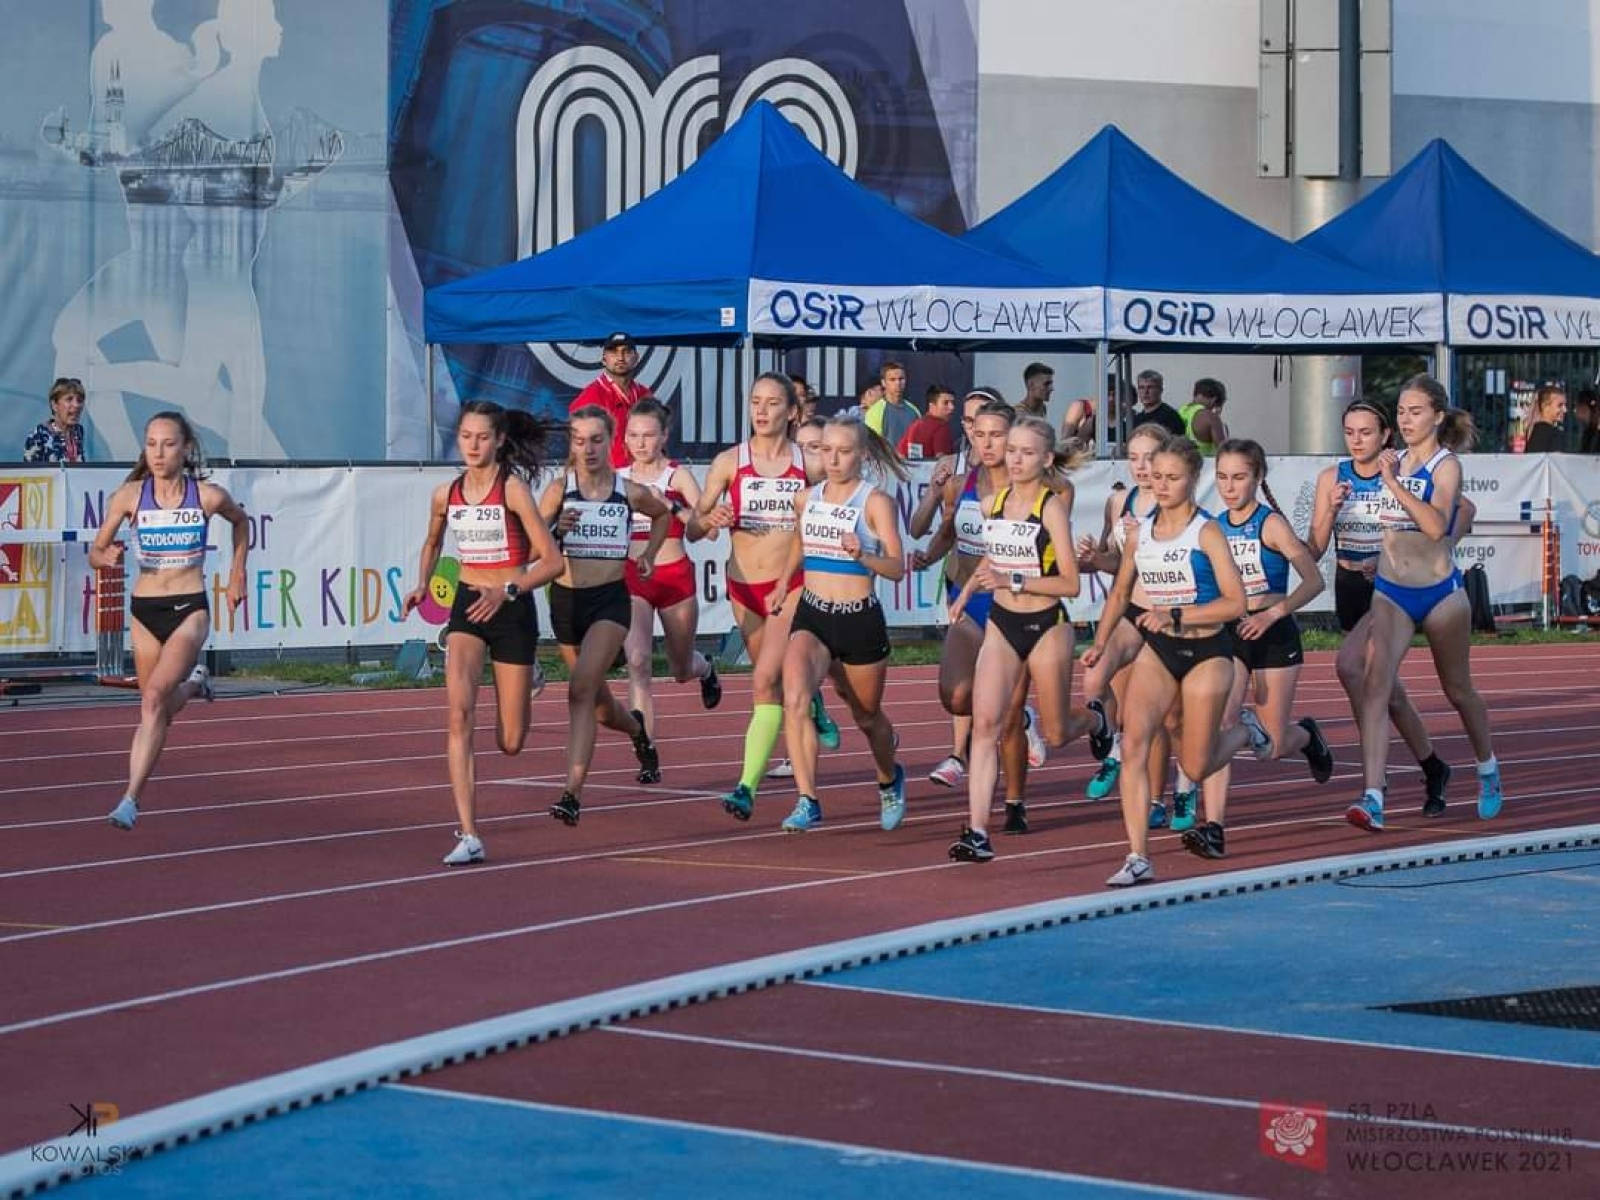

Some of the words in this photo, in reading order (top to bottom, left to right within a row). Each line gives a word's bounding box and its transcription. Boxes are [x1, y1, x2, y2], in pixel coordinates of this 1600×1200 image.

[771, 289, 864, 331] OSiR
[876, 298, 1082, 334] WŁOCŁAWEK
[1123, 297, 1215, 337] OSiR
[1226, 306, 1425, 339] WŁOCŁAWEK
[1467, 303, 1549, 340] OSiR
[172, 511, 200, 524] 706
[476, 508, 500, 521] 298
[598, 506, 625, 520] 669
[830, 508, 856, 525] 462
[573, 523, 618, 540] RĘBISZ
[1010, 523, 1035, 537] 707
[1162, 549, 1188, 563] 667
[1233, 542, 1256, 556] 174
[1141, 570, 1187, 584] DZIUBA
[322, 566, 403, 630] KIDS
[831, 599, 863, 614] PRO
